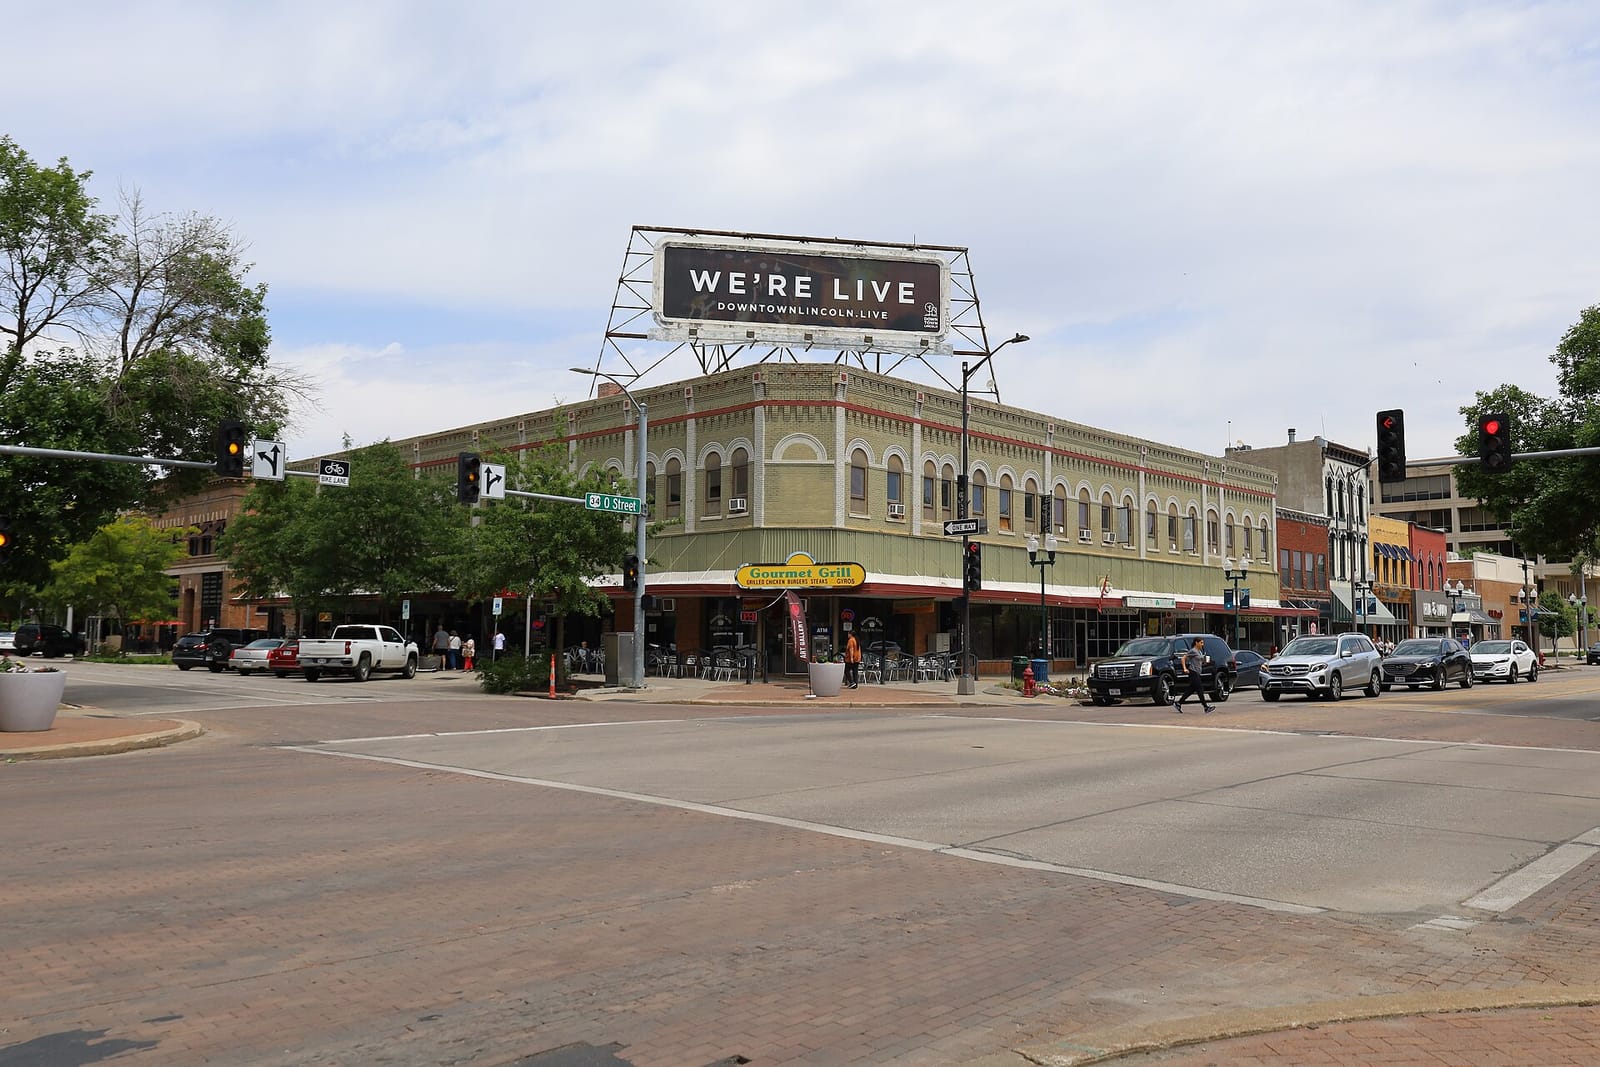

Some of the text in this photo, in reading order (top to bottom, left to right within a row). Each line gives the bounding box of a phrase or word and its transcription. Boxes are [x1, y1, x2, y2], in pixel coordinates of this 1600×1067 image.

[689, 269, 916, 304] WE'RE LIVE
[717, 302, 889, 320] DOWNTOWNLINCOLN.LIVE
[604, 496, 610, 509] O
[612, 497, 636, 511] Street
[963, 522, 976, 531] WAY
[749, 567, 852, 578] Gourmet Grill
[797, 620, 807, 659] ART GALLERY
